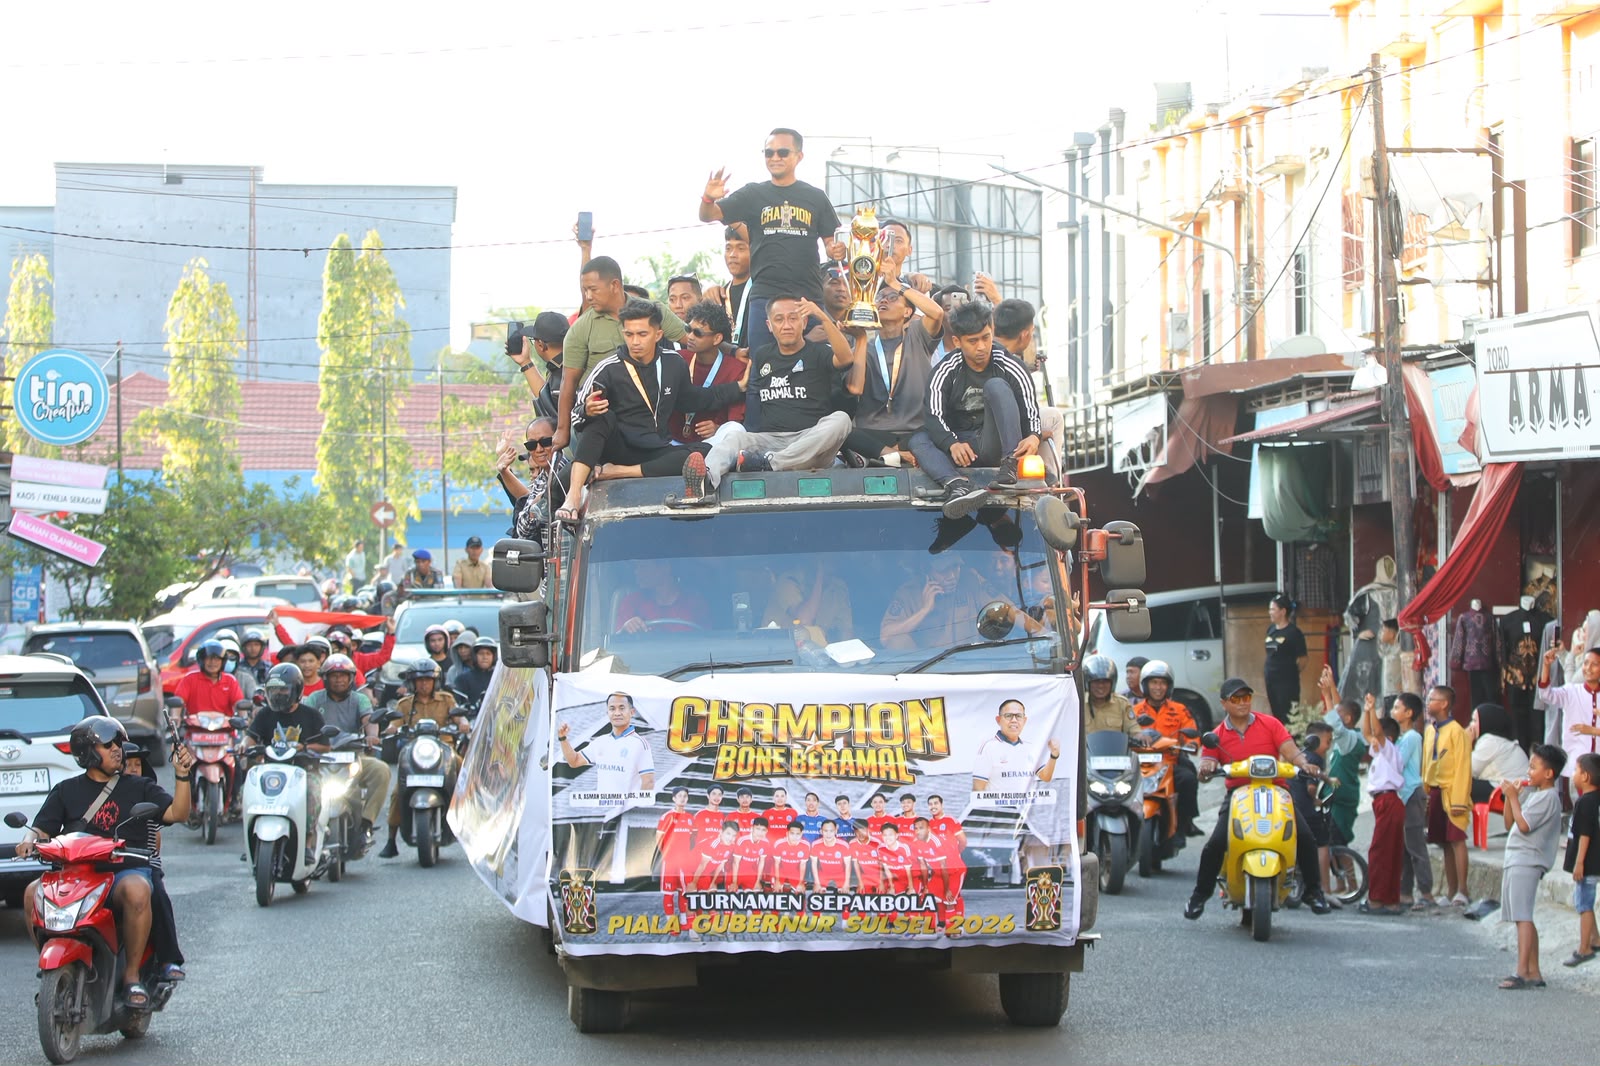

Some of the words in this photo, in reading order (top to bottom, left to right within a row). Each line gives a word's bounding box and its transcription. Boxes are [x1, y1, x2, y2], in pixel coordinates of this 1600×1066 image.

[1487, 346, 1510, 371] TOKO
[30, 369, 93, 407] tim
[770, 375, 790, 388] BONE
[795, 387, 807, 399] FC
[1508, 363, 1591, 434] ARMA
[32, 400, 91, 422] Creative
[16, 492, 36, 501] KAOS
[42, 494, 68, 503] KEMEJA
[69, 495, 103, 505] SERAGAM
[17, 519, 48, 538] PAKAIAN
[49, 532, 88, 554] OLAHRAGA
[667, 696, 950, 759] CHAMPION
[713, 744, 788, 782] BONE
[789, 746, 916, 785] BERAMAL
[0, 772, 23, 785] 825
[34, 770, 46, 784] AY
[983, 792, 1000, 800] AKMAL
[685, 893, 803, 912] TURNAMEN
[810, 894, 937, 912] SEPAKBOLA
[607, 914, 681, 935] PIALA
[692, 914, 835, 935] GUBERNUR
[845, 914, 936, 934] SULSEL
[945, 913, 1016, 934] 2026
